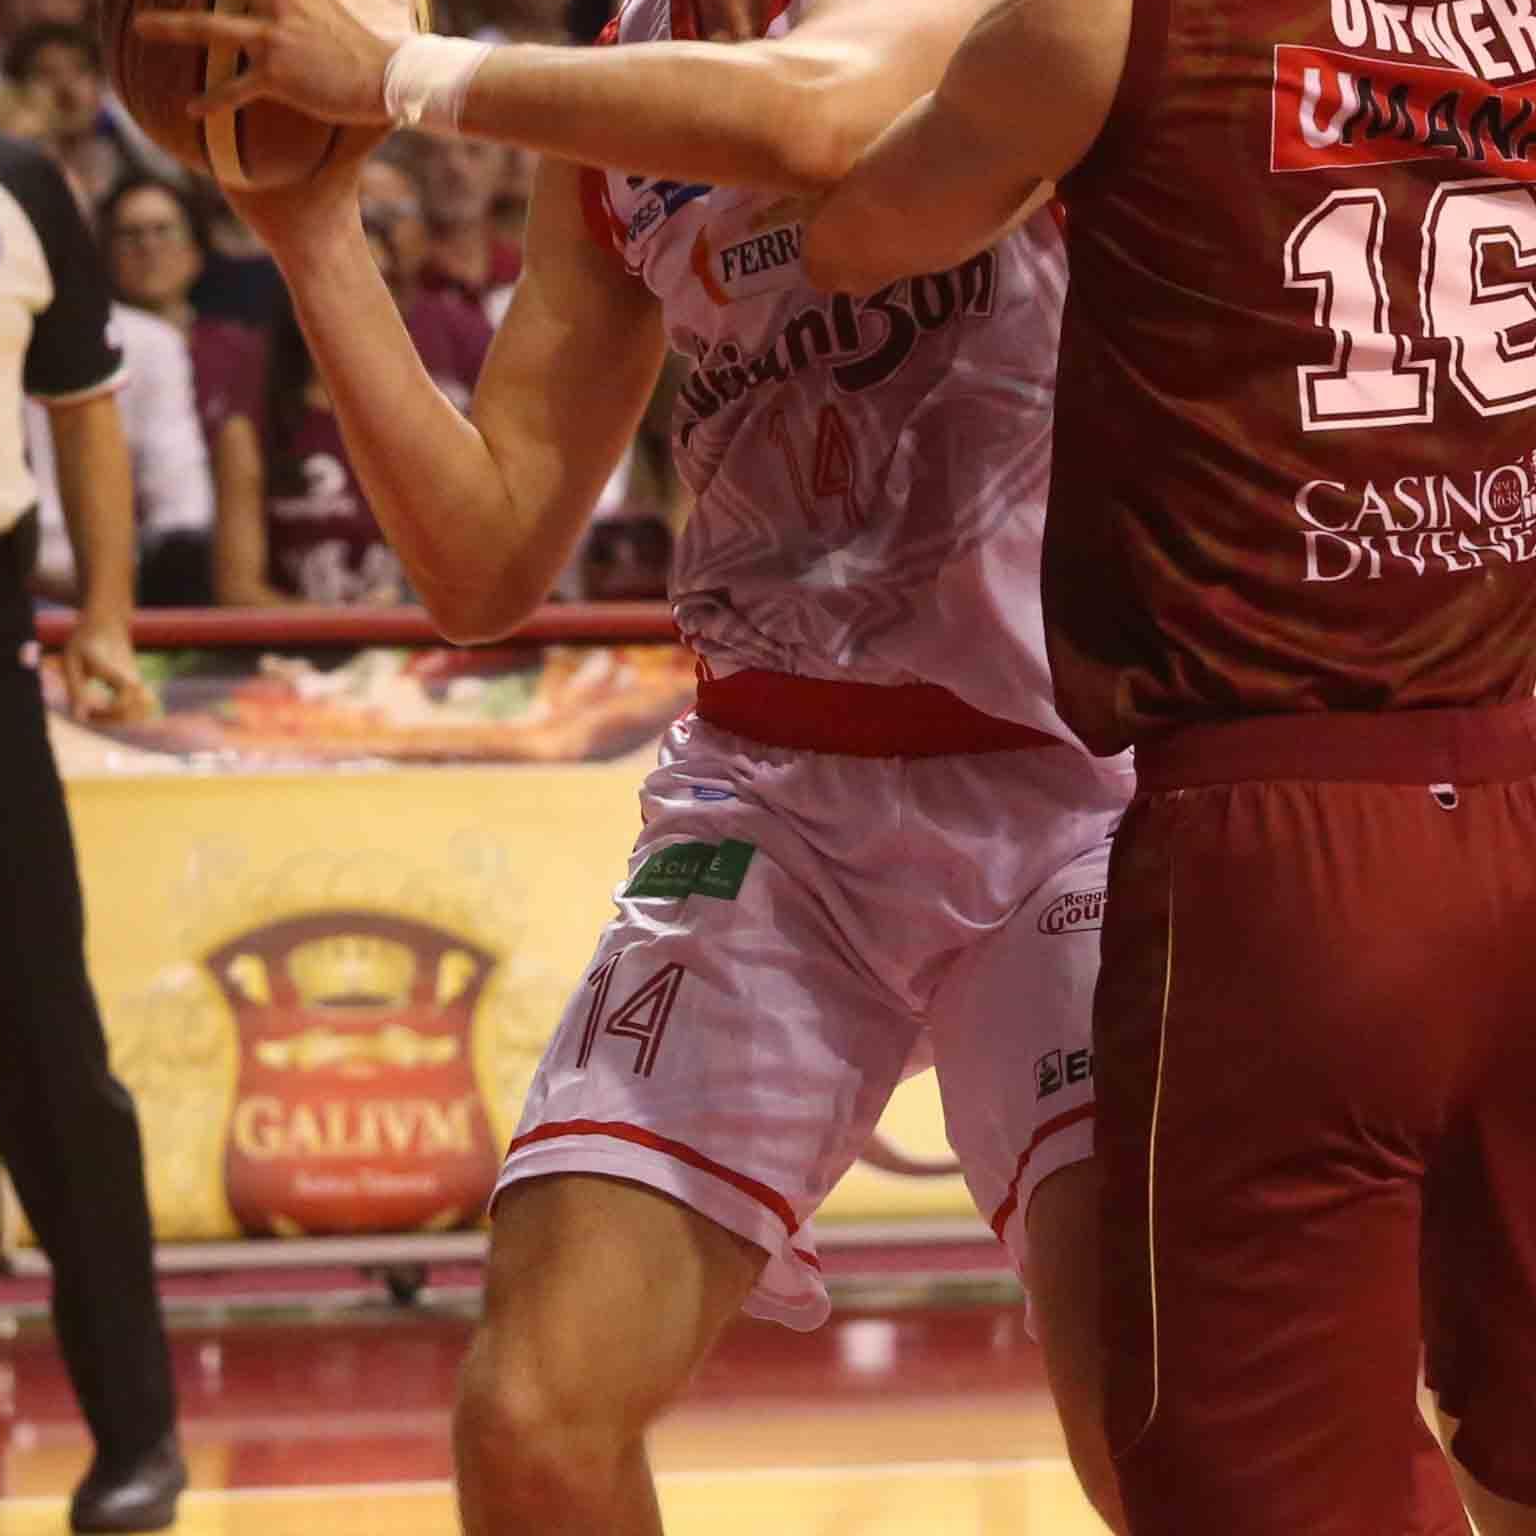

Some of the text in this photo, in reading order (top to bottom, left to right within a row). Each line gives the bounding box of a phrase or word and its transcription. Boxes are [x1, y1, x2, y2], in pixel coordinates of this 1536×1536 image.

[720, 225, 803, 283] FERR
[1046, 902, 1101, 934] Gou
[572, 951, 686, 1078] 14
[234, 1096, 481, 1162] GALIVM
